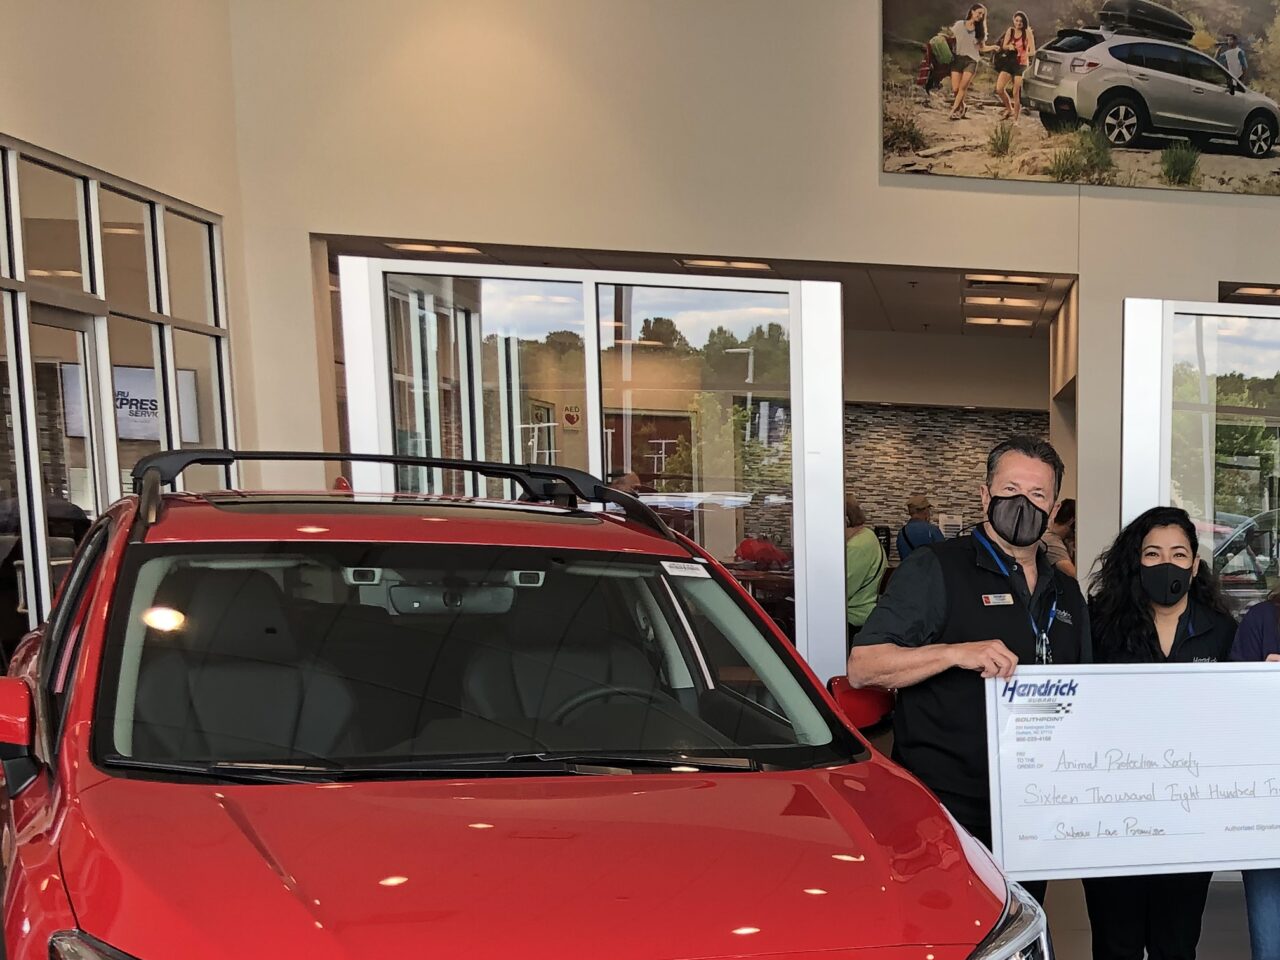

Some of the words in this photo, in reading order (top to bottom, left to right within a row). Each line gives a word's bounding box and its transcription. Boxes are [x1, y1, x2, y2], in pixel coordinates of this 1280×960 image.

[1002, 679, 1079, 703] Hendrick
[1056, 750, 1098, 772] Animal
[1023, 783, 1079, 804] Sixteen
[1085, 782, 1156, 804] Thousand
[1164, 782, 1201, 812] Eight
[1208, 781, 1256, 799] Hundred
